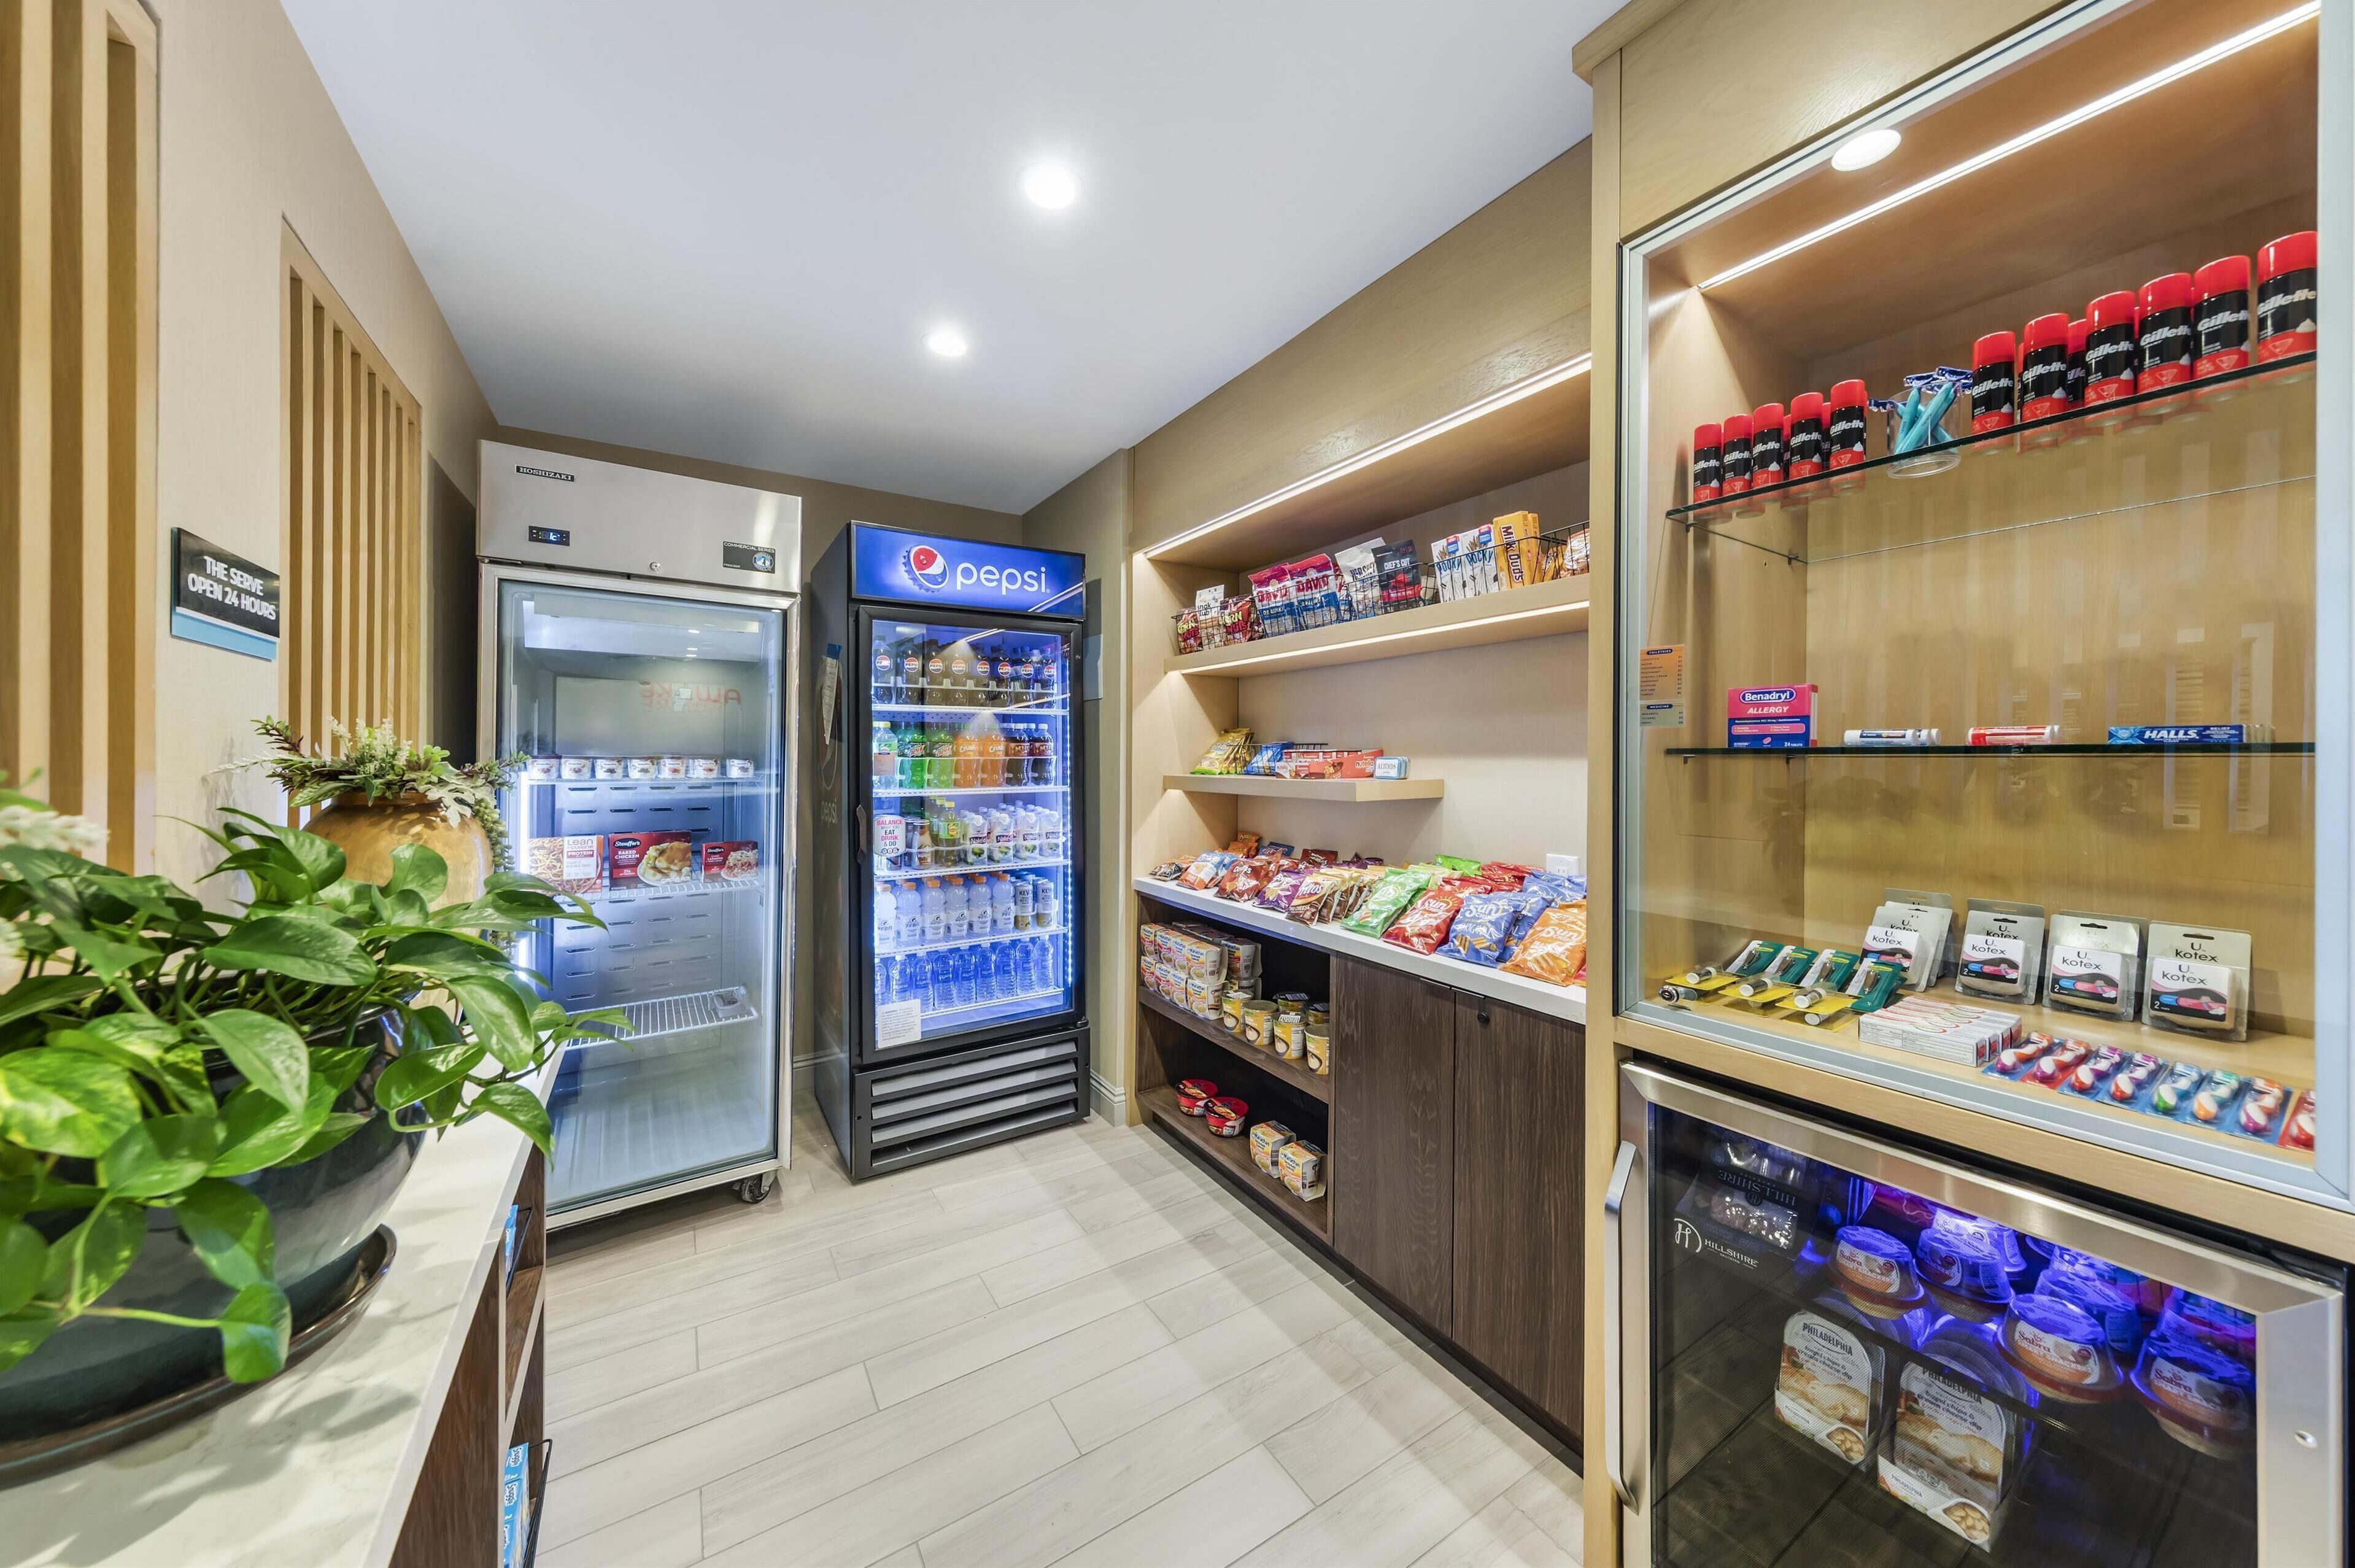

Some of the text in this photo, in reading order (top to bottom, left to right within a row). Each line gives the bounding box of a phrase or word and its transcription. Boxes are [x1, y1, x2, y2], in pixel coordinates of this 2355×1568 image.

[2086, 341, 2134, 361] Gillette
[2022, 361, 2067, 382] Gillette
[1972, 378, 2013, 396] Gillette
[1830, 420, 1863, 434] Gillette
[1790, 432, 1822, 446] Gillette
[1694, 459, 1720, 471] illette
[519, 467, 572, 481] HOSHIZAKI
[724, 542, 757, 550] COMMERCIAL
[1501, 525, 1517, 551] Milk
[1384, 558, 1410, 570] CHEF'S CUT
[1466, 550, 1493, 566] POCKY
[204, 555, 263, 596] THE SERVE
[1509, 553, 1524, 582] Duds
[956, 563, 1046, 595] pepsi
[1296, 574, 1328, 593] DAVID
[188, 573, 276, 620] OPEN 24 HOURS
[1745, 691, 1789, 701] Benadryl
[2144, 730, 2197, 738] HALLS
[989, 744, 1005, 753] Crush
[821, 799, 837, 825] pepsi
[1872, 936, 1902, 946] kotex
[1972, 944, 2006, 956] kotex
[2175, 949, 2218, 963] kotex
[2062, 957, 2102, 971] kotex
[2179, 964, 2190, 973] U
[2162, 971, 2207, 985] kotex
[1705, 1239, 1758, 1267] HILLSHIRE
[1839, 1251, 1862, 1267] Sabra
[1803, 1322, 1852, 1356] PHILADELPHIA
[2019, 1330, 2051, 1353] Sabra
[2154, 1369, 2192, 1393] Sabra
